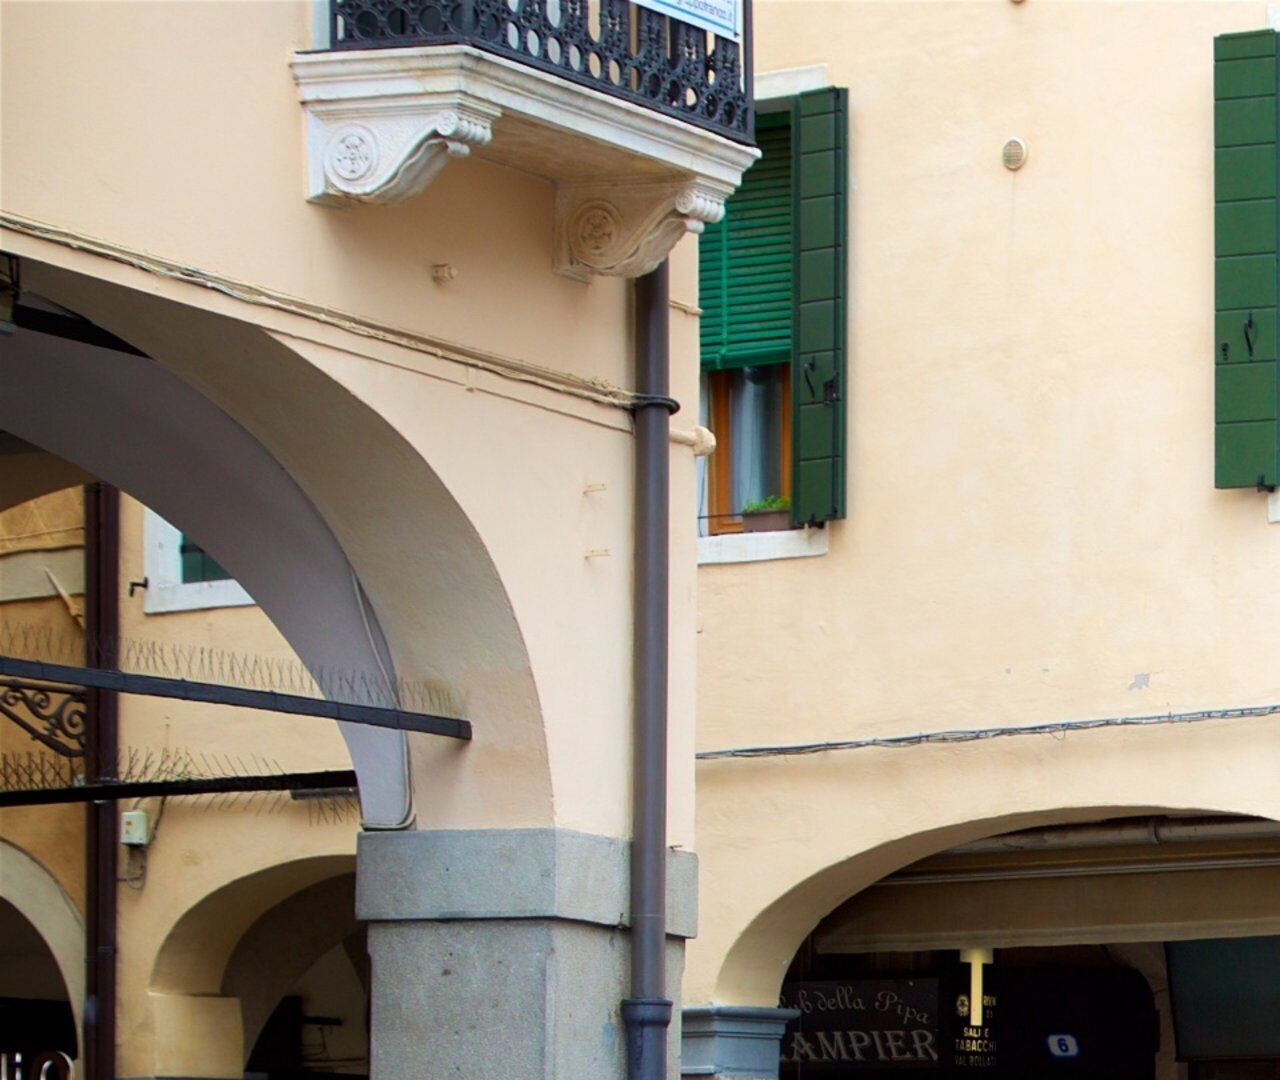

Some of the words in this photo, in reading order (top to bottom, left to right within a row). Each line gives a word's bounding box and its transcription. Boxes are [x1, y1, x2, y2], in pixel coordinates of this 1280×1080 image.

[813, 985, 864, 1012] della
[874, 990, 930, 1024] Pipa
[781, 1028, 939, 1062] AMPIER
[1057, 1038, 1069, 1053] 6
